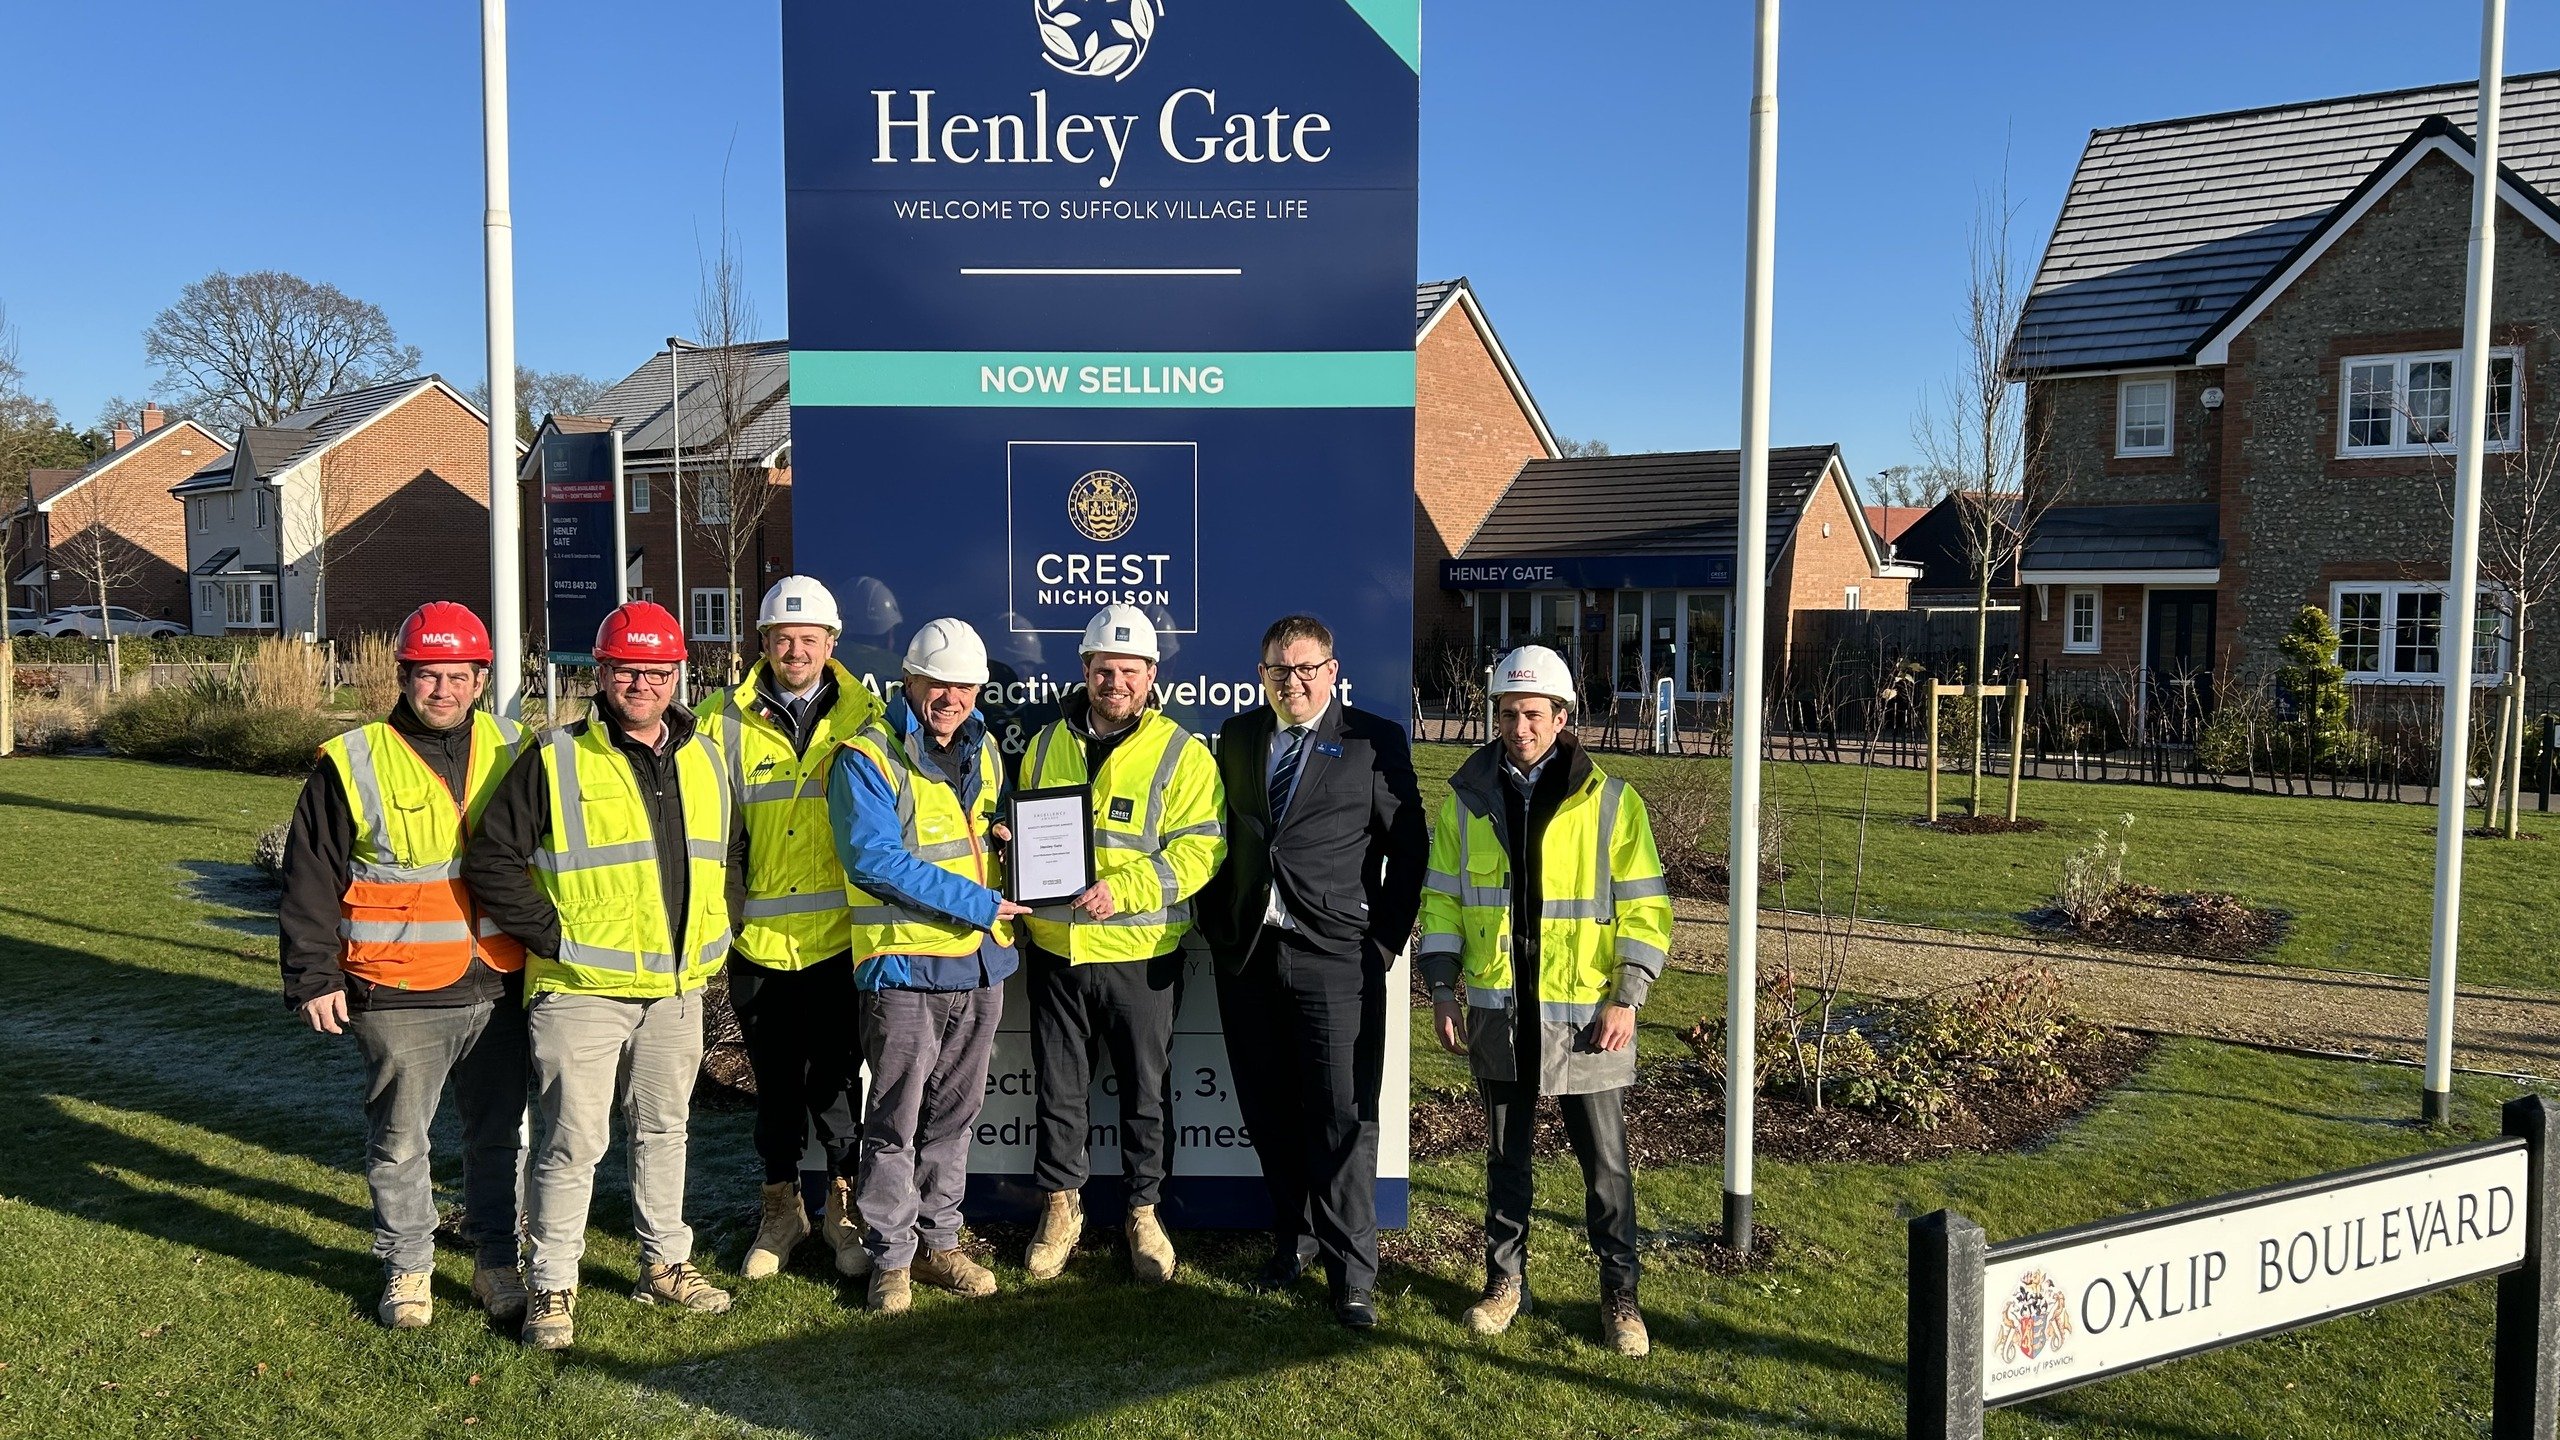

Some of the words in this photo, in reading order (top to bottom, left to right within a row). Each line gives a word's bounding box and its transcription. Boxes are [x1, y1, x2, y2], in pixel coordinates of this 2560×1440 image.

[870, 88, 1139, 188] Henley
[1159, 87, 1331, 164] Gate
[894, 200, 1012, 220] WELCOME
[1018, 200, 1050, 220] TO
[1060, 200, 1159, 220] SUFFOLK
[1164, 200, 1256, 220] VILLAGE
[1266, 200, 1308, 219] LIFE
[981, 366, 1069, 393] NOW
[1079, 366, 1224, 394] SELLING
[553, 527, 577, 535] HENLEY
[553, 538, 570, 546] GATE
[1036, 553, 1171, 585] CREST
[1449, 567, 1508, 580] HENLEY
[1512, 566, 1553, 580] GATE
[554, 581, 571, 589] 01473
[572, 581, 584, 589] 849
[1038, 590, 1169, 605] NICHOLSON
[422, 633, 458, 644] MACL
[627, 633, 660, 644] MACL
[1507, 670, 1537, 679] MACL
[1001, 725, 1026, 754] &
[2081, 1250, 2227, 1335] OXLIP
[2257, 1185, 2514, 1294] BOULEVARD
[1991, 1366, 2031, 1382] BOROUGH
[2033, 1362, 2041, 1374] of
[2042, 1355, 2074, 1370] IPSWICH
